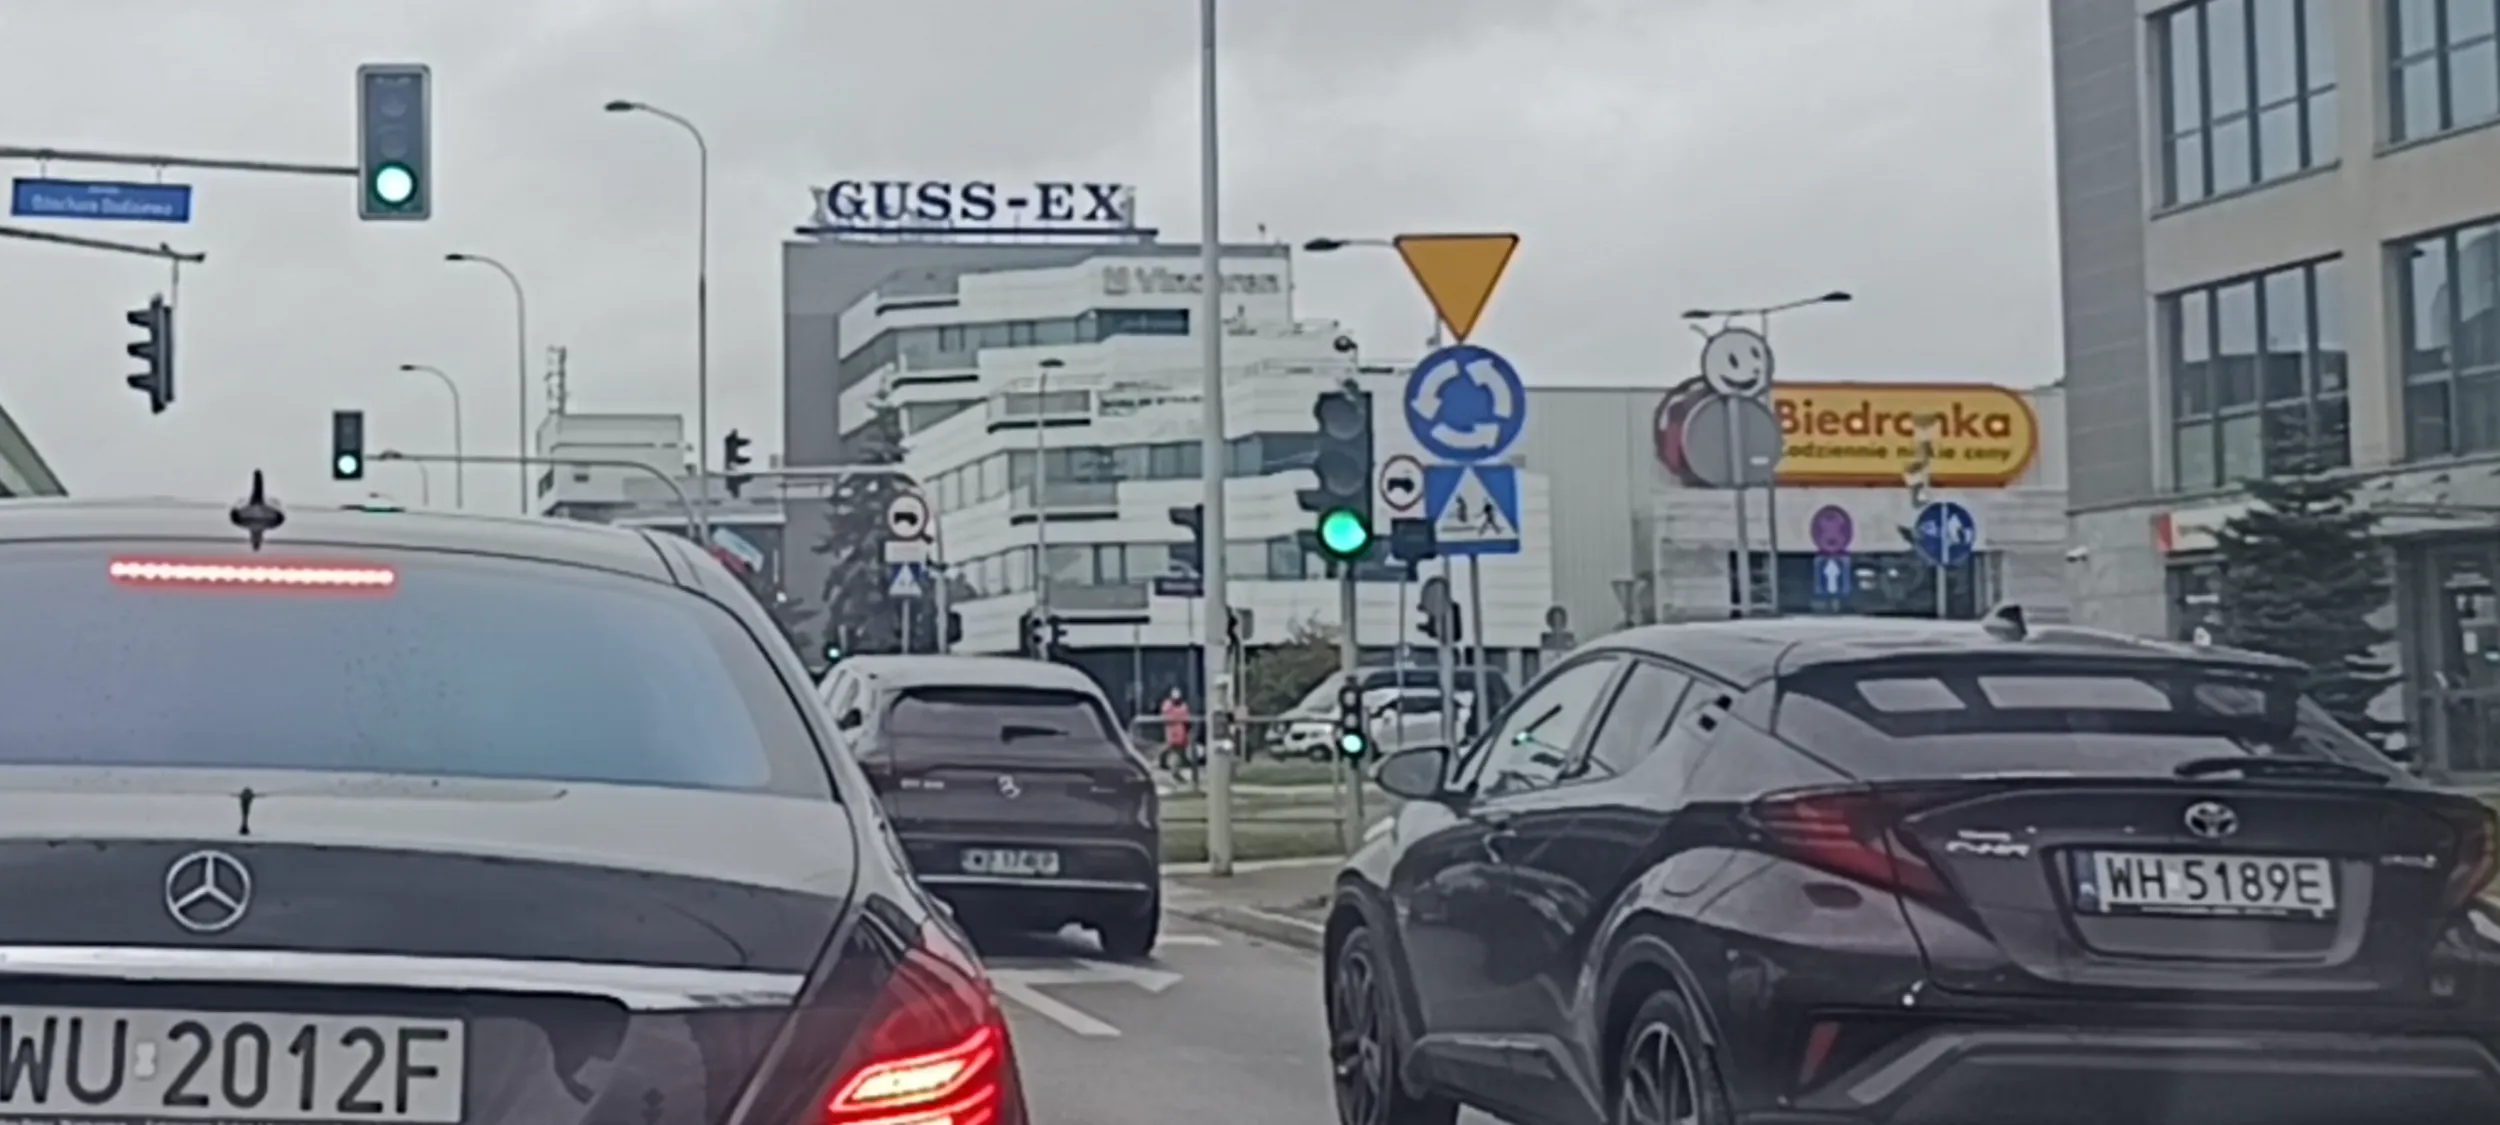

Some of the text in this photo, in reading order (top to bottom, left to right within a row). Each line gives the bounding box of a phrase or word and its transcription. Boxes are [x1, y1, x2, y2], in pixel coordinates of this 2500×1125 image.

[827, 180, 1123, 221] GUSS-EX
[2105, 857, 2323, 904] WH 5189E
[0, 1015, 449, 1114] WU 2012F
